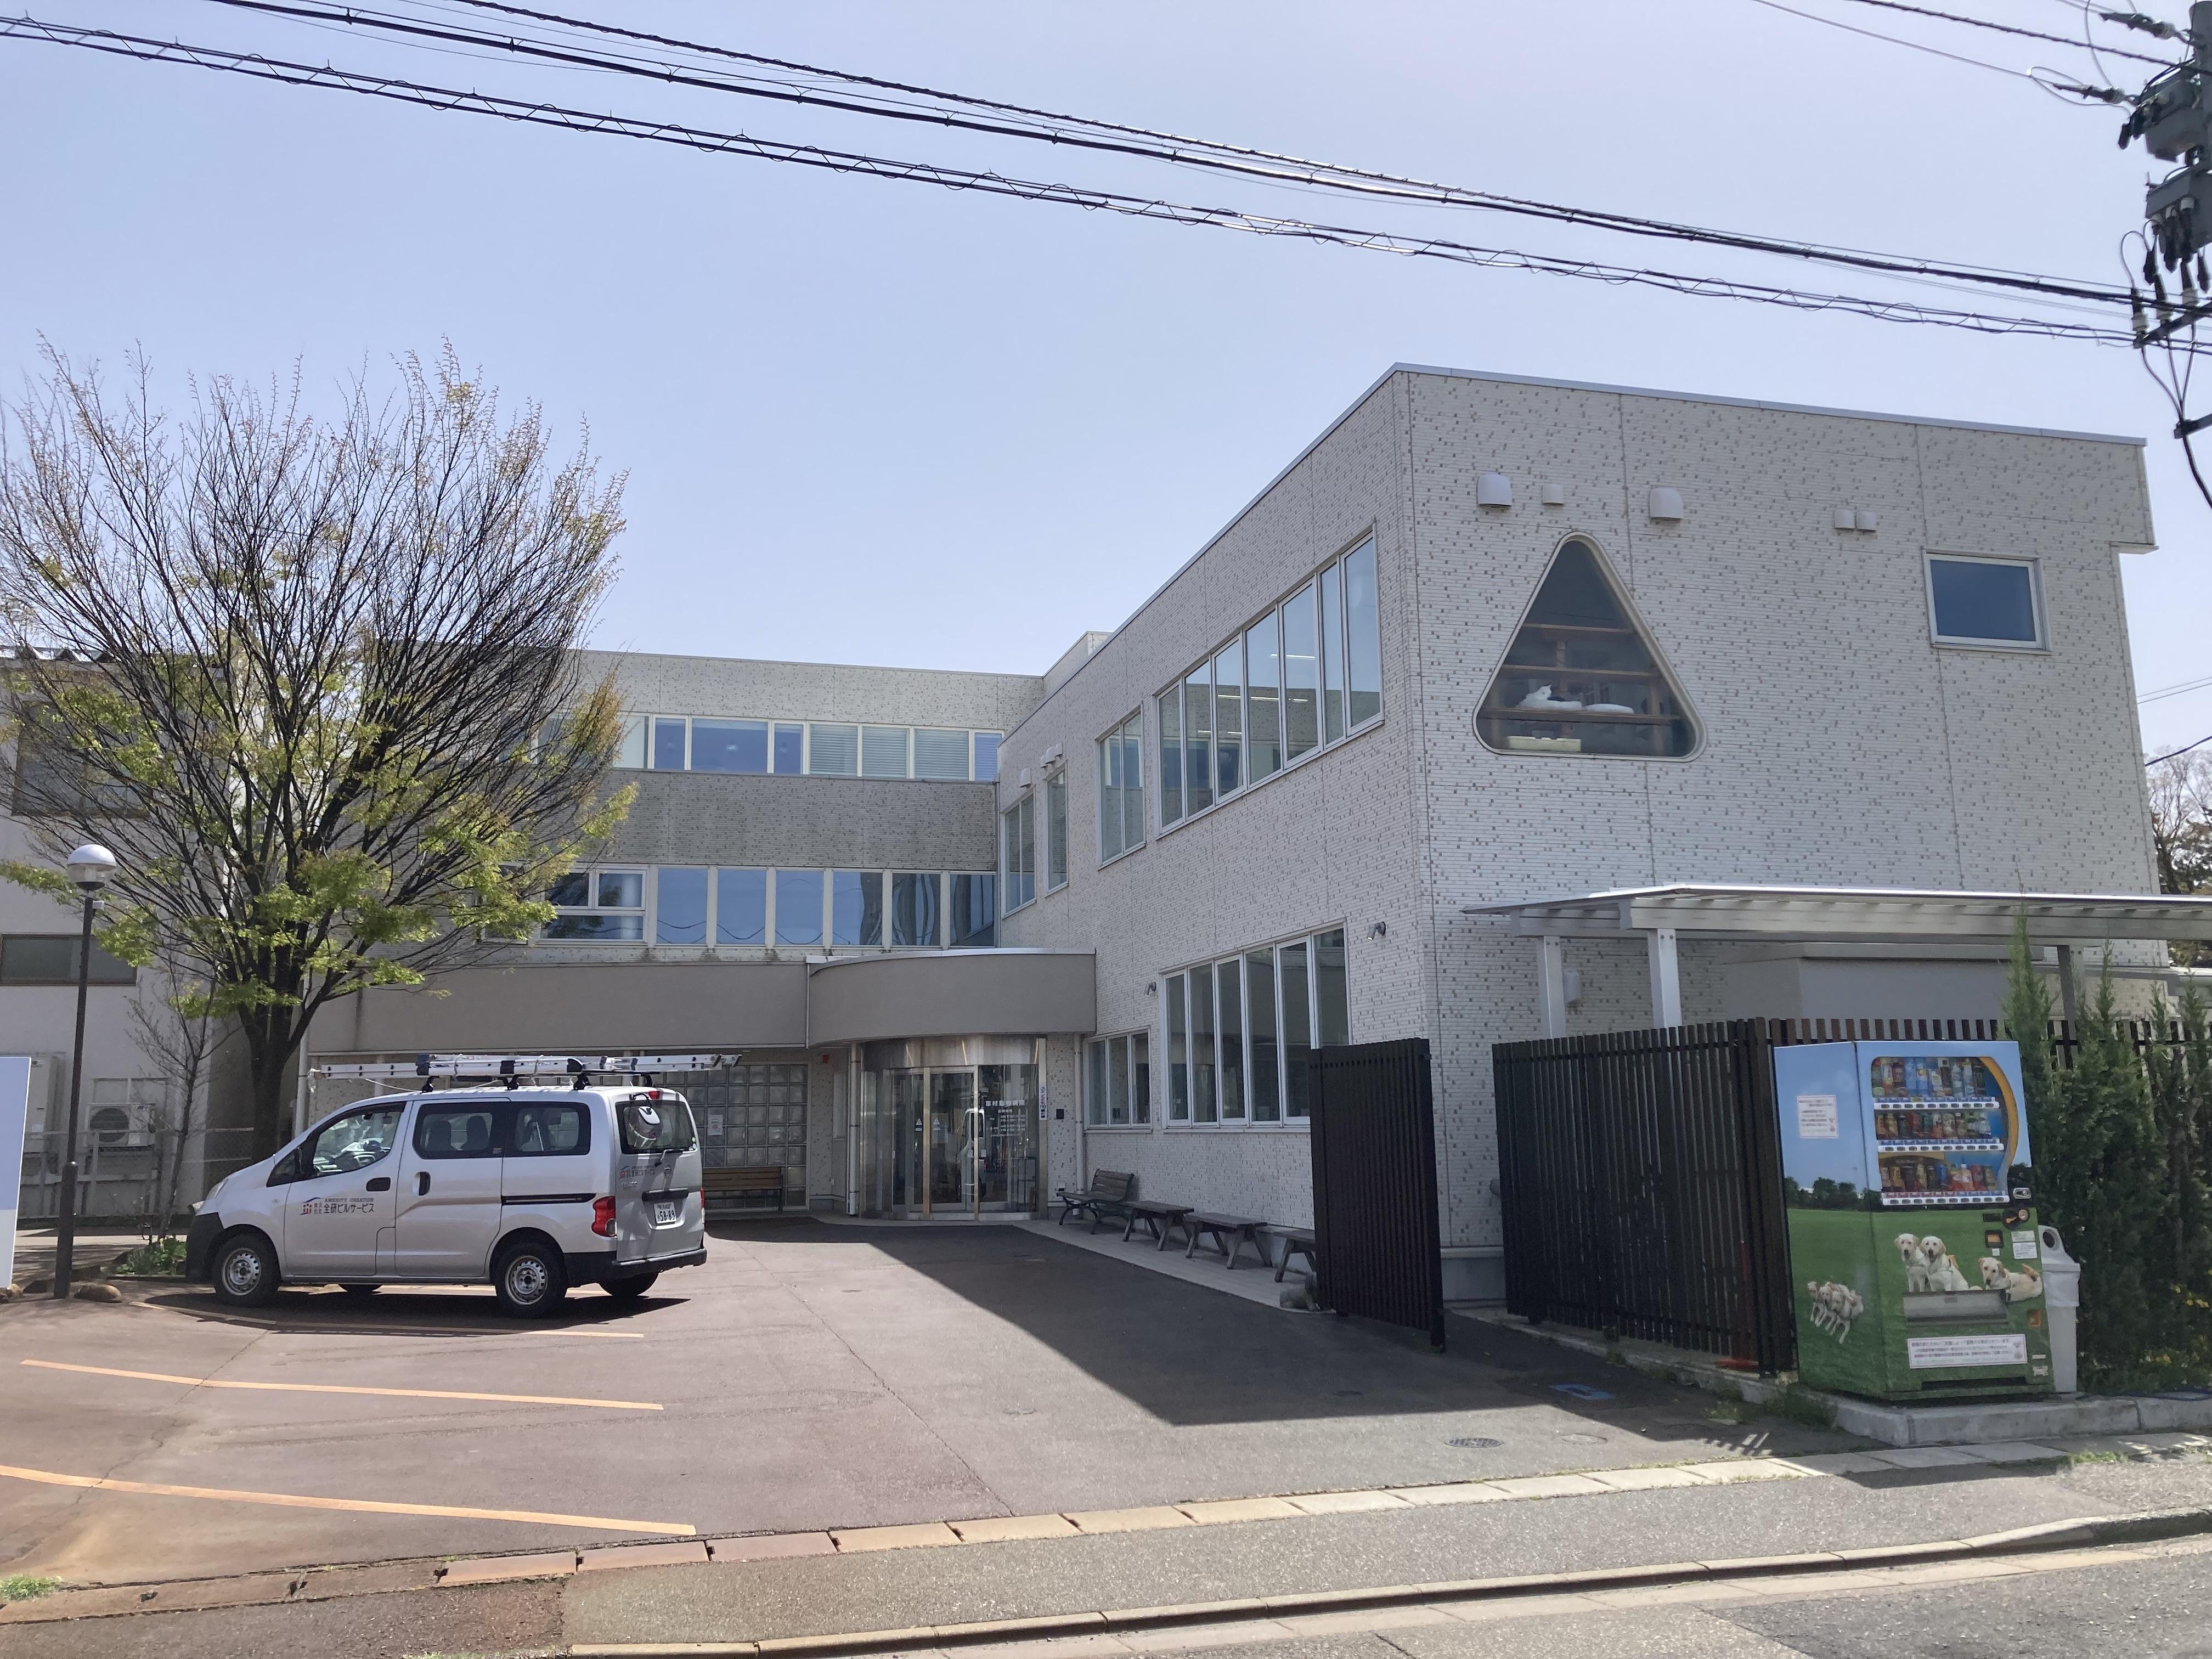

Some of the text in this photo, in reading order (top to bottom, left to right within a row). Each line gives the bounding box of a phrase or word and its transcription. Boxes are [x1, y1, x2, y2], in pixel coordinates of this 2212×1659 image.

[324, 1203, 374, 1214] 全研ビルサービス
